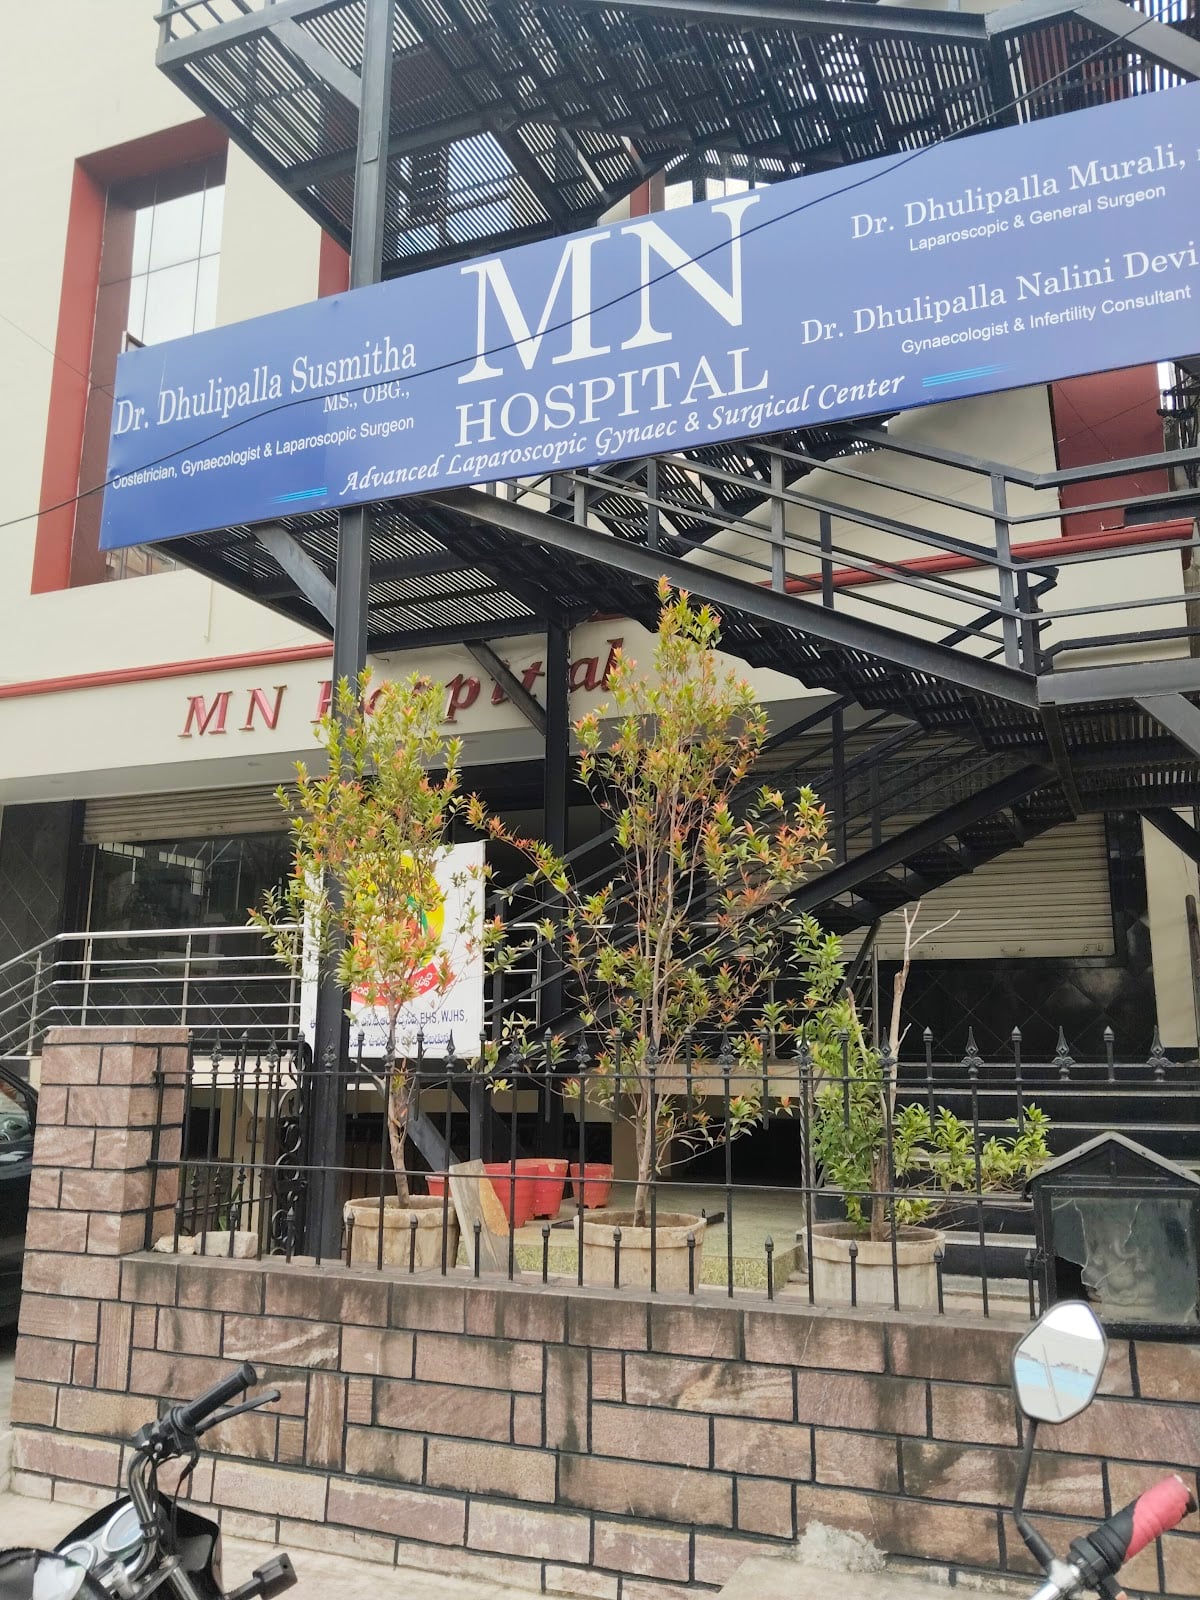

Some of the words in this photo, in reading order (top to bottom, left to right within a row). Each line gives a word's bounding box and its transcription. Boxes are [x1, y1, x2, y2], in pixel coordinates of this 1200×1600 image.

[851, 214, 894, 239] Dr.
[904, 174, 1060, 227] Dhulipalla
[1068, 144, 1185, 190] Murali,
[910, 220, 1008, 251] Laparoscopic
[1014, 215, 1025, 228] &
[1030, 199, 1091, 224] General
[1097, 186, 1165, 209] Surgeon
[458, 194, 760, 385] MN
[801, 320, 843, 344] Dr.
[853, 284, 1009, 334] Dhulipalla
[1016, 258, 1114, 300] Nalini
[1123, 241, 1199, 278] Devi
[902, 321, 1009, 354] Gynaecologist
[1014, 318, 1025, 331] &
[1031, 306, 1096, 328] Infertility
[1102, 285, 1191, 314] Consultant
[114, 399, 148, 434] Dr.
[157, 366, 282, 425] Dhulipalla
[291, 336, 416, 395] Susmitha
[323, 393, 357, 412] MS.,
[363, 381, 409, 404] OBG.,
[454, 347, 769, 448] HOSPITAL
[113, 466, 177, 489] Obstetrician,
[181, 445, 261, 476] Gynaecologist
[264, 442, 272, 457] &
[276, 426, 356, 455] Laparoscopic
[360, 417, 414, 437] Surgeon
[339, 454, 445, 495] Advanced
[446, 433, 587, 477] Laparoscopic
[595, 420, 677, 458] Gynaec
[685, 412, 699, 432] &
[707, 395, 811, 432] Surgical
[819, 376, 905, 409] Center
[310, 637, 625, 725] opital
